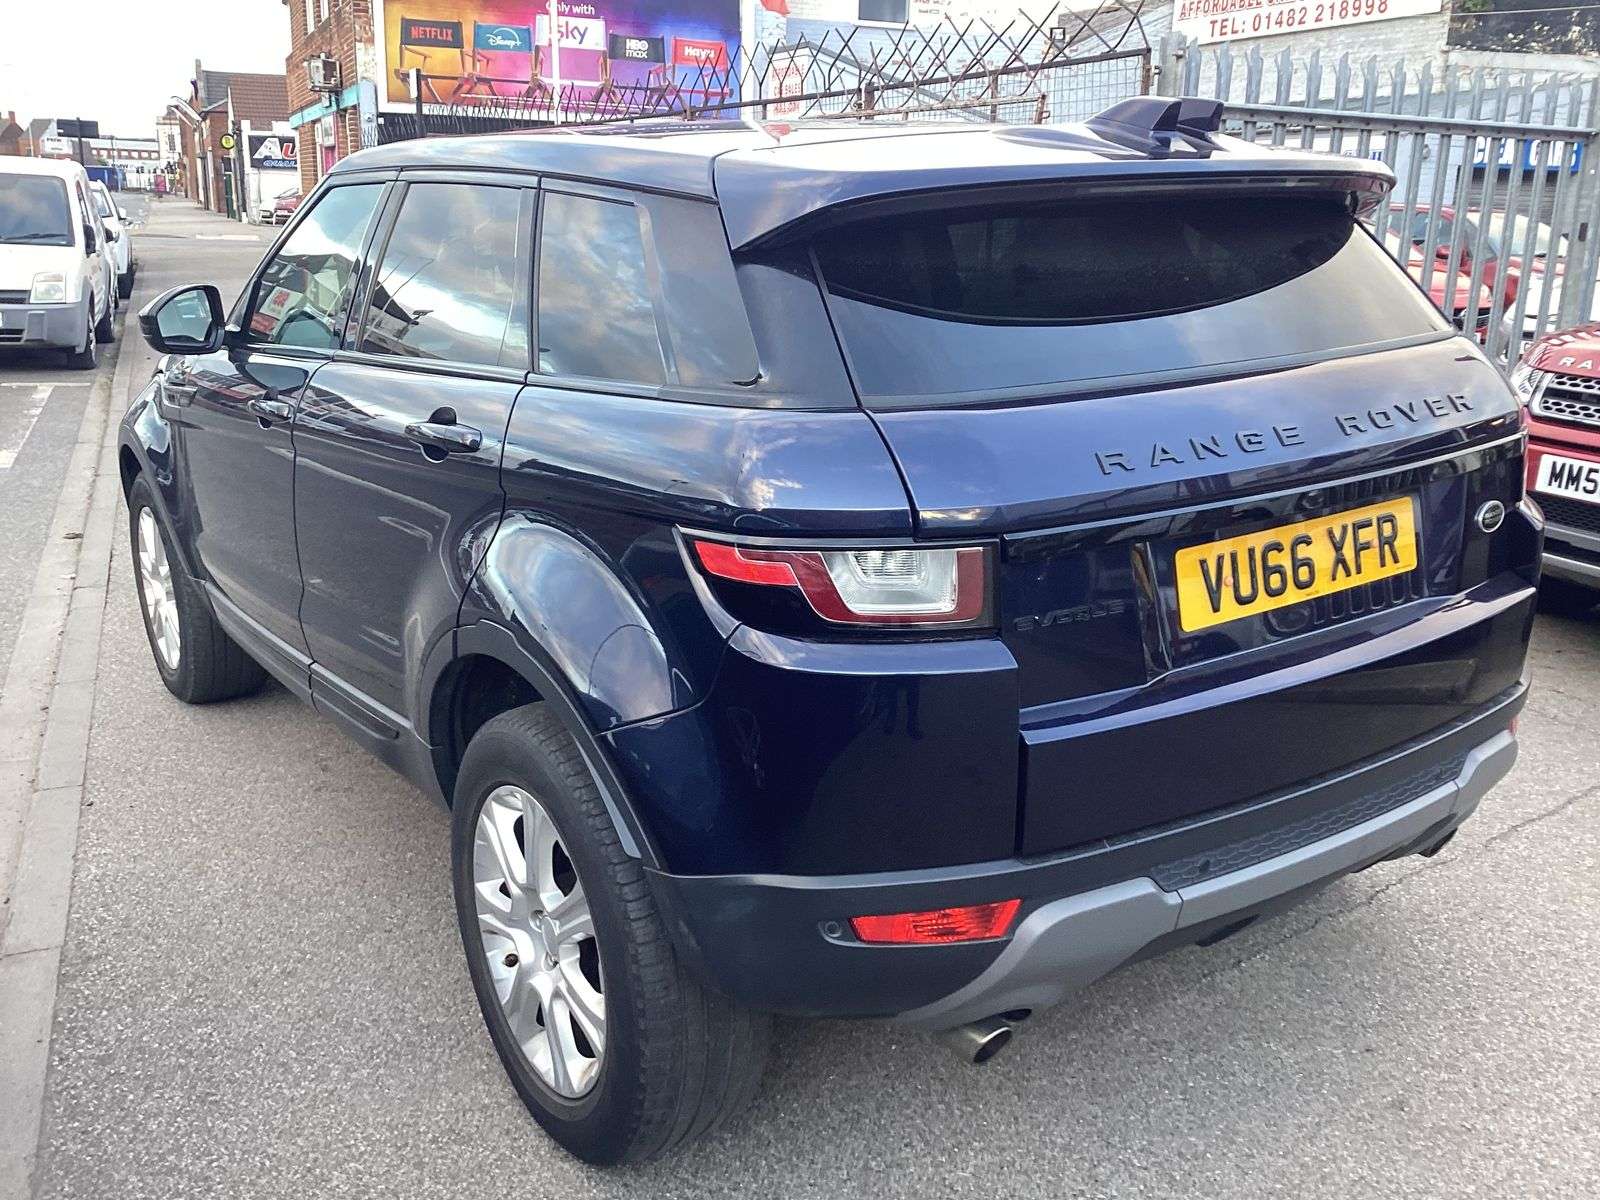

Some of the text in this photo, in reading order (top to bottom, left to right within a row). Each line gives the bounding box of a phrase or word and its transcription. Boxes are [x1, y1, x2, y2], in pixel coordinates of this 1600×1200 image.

[572, 4, 595, 15] with
[1179, 0, 1263, 18] AFFORDAB
[1210, 0, 1388, 37] TEL: 01482 218998
[410, 26, 453, 42] NETFLIX
[625, 38, 649, 50] HBO
[625, 49, 648, 58] max
[1558, 356, 1600, 370] RA
[1095, 391, 1475, 476] RANGE ROVER
[1199, 511, 1400, 614] VU66 XFR
